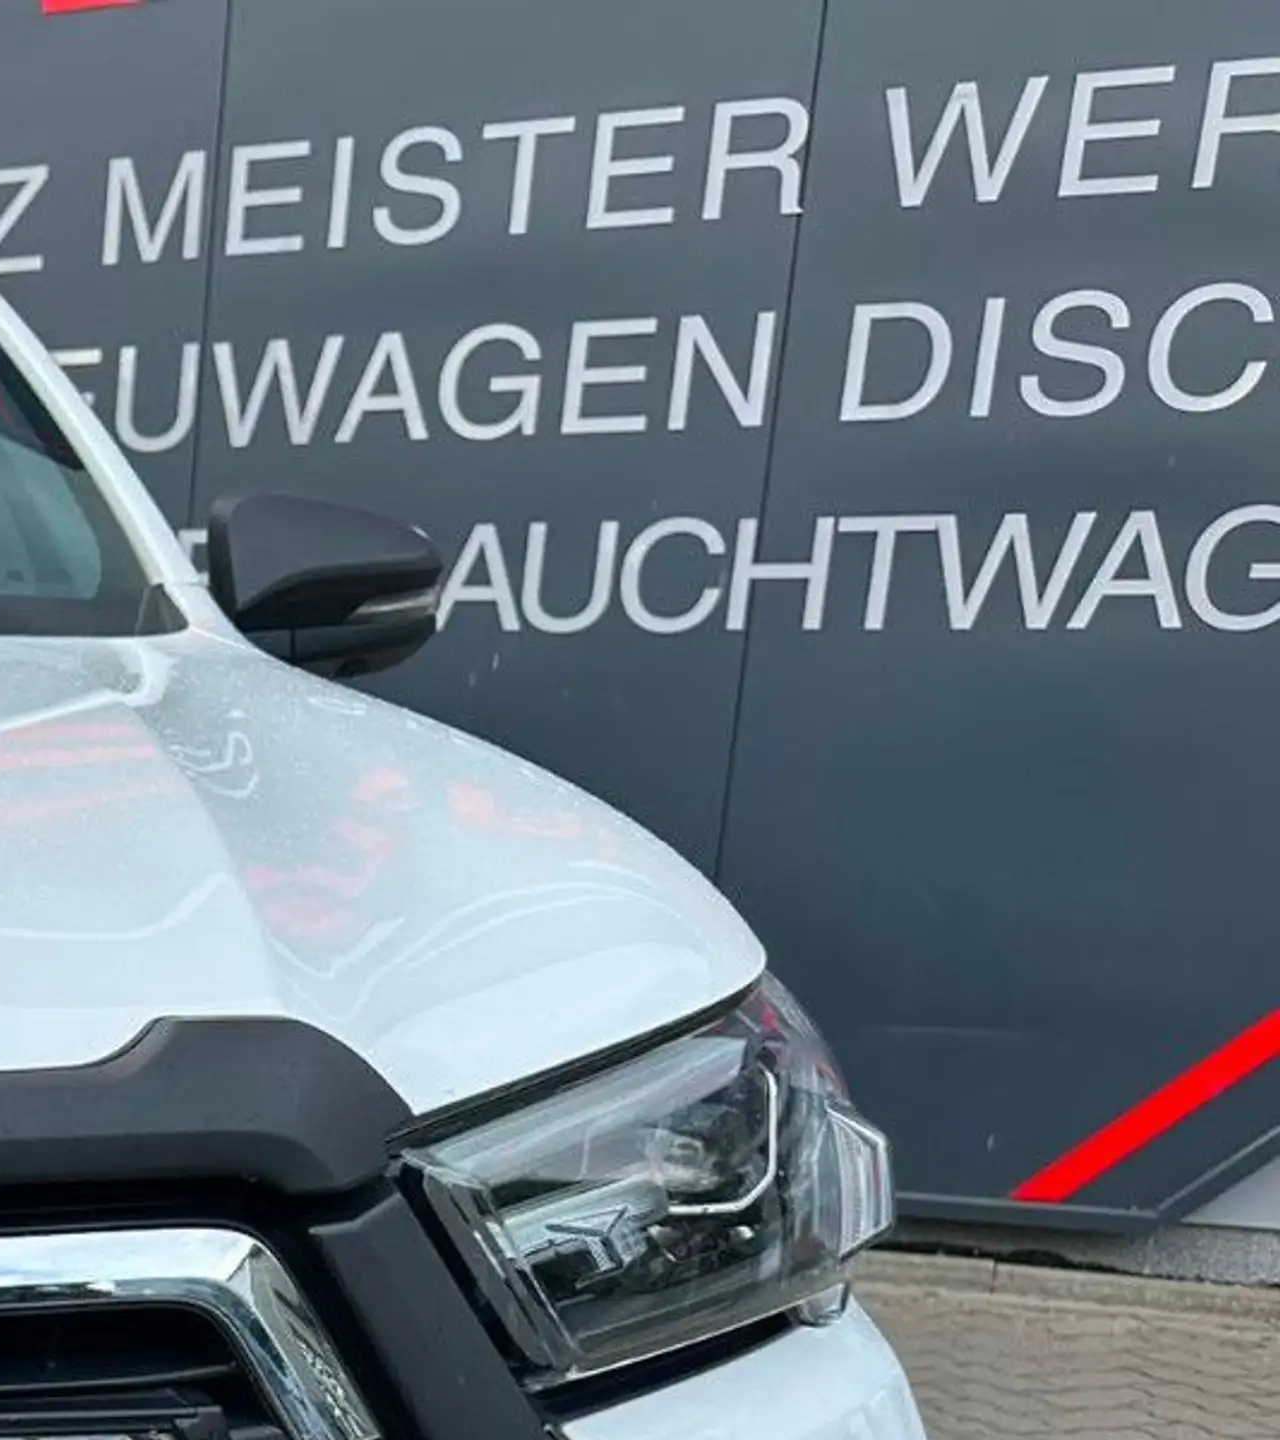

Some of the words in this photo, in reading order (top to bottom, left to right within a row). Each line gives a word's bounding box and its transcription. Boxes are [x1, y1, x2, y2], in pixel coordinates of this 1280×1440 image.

[101, 97, 811, 266] MEISTER
[49, 311, 776, 453] UWAGEN
[839, 281, 1276, 422] DISC
[177, 504, 1280, 634] AUCHTWAG
